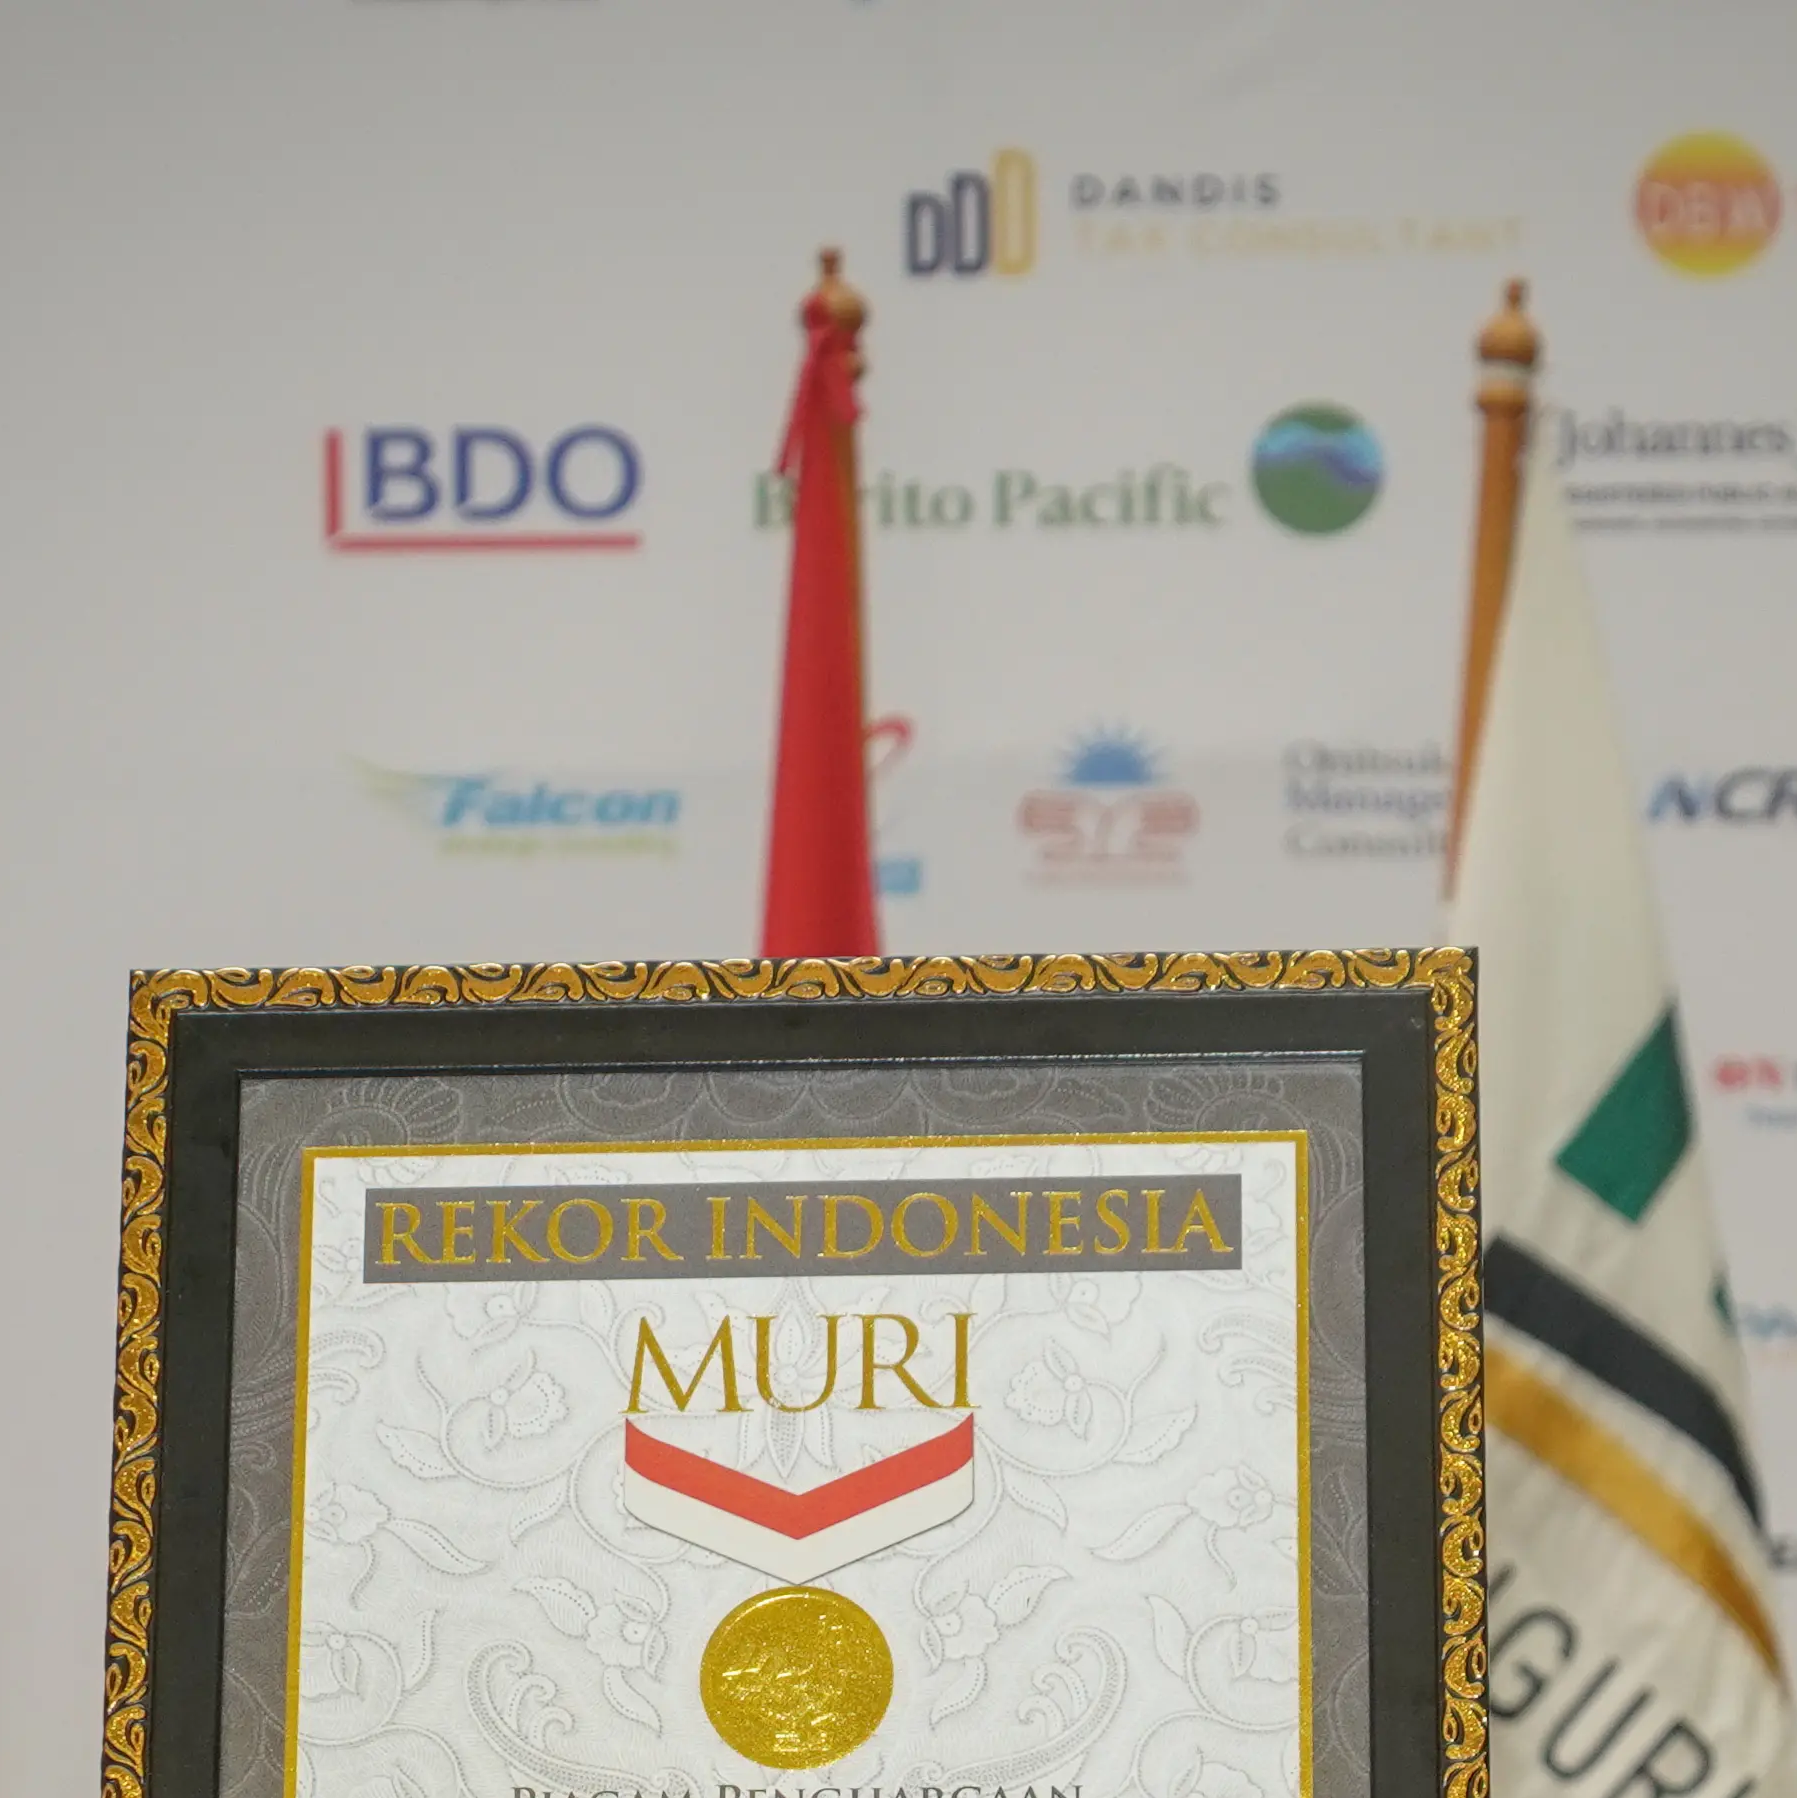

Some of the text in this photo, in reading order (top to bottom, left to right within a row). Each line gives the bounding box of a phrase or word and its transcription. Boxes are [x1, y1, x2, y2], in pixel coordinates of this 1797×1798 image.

[1070, 174, 1282, 211] DANDIS
[1076, 217, 1166, 255] TAX
[1557, 405, 1796, 468] Johannes
[362, 427, 643, 521] BDO
[754, 462, 1229, 529] Brito Pacific
[438, 775, 683, 828] Falcon
[378, 1188, 1232, 1266] REKOR INDONESIA
[622, 1312, 976, 1415] MURI
